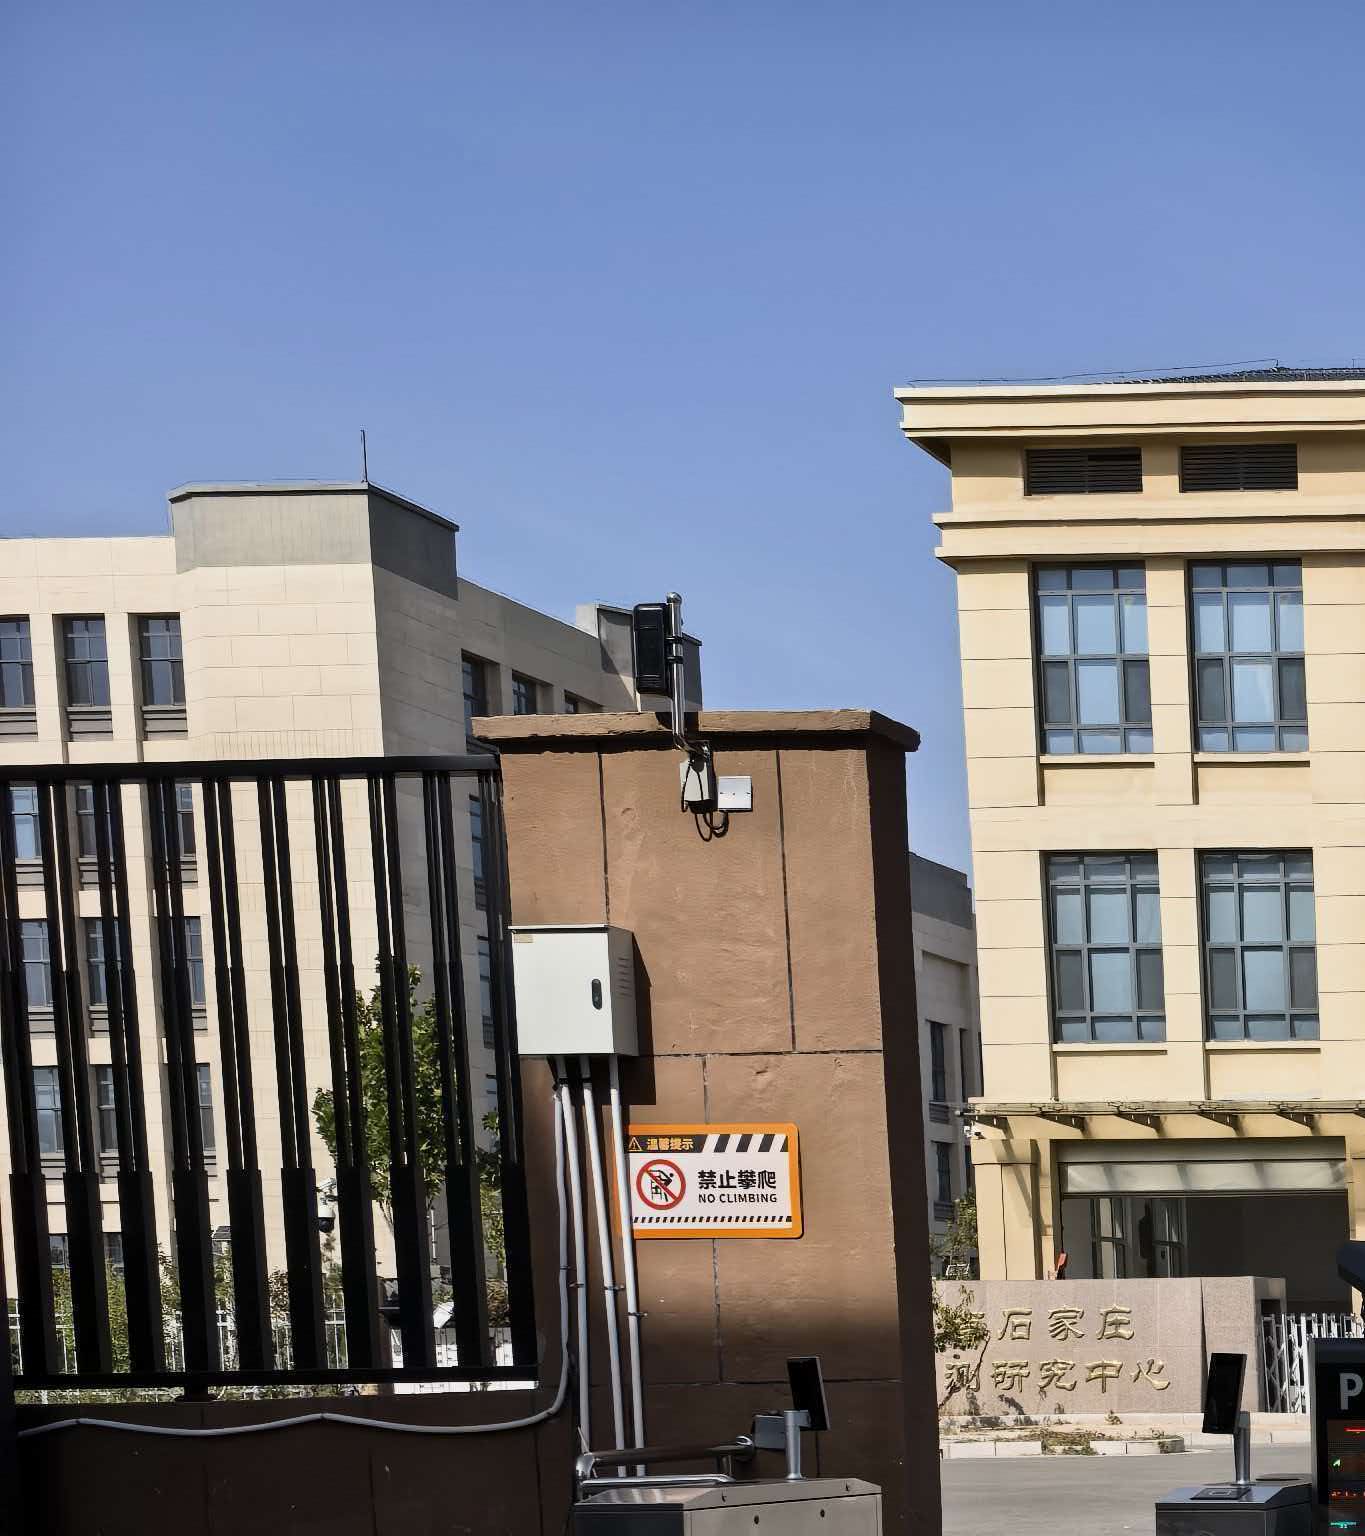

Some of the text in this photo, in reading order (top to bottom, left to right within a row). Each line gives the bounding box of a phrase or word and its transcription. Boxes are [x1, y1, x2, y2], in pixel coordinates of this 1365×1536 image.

[697, 1169, 777, 1190] 禁止攀爬
[698, 1193, 777, 1204] NO CLIMBING
[957, 1304, 1136, 1342] 石家庄
[1338, 1372, 1364, 1411] P
